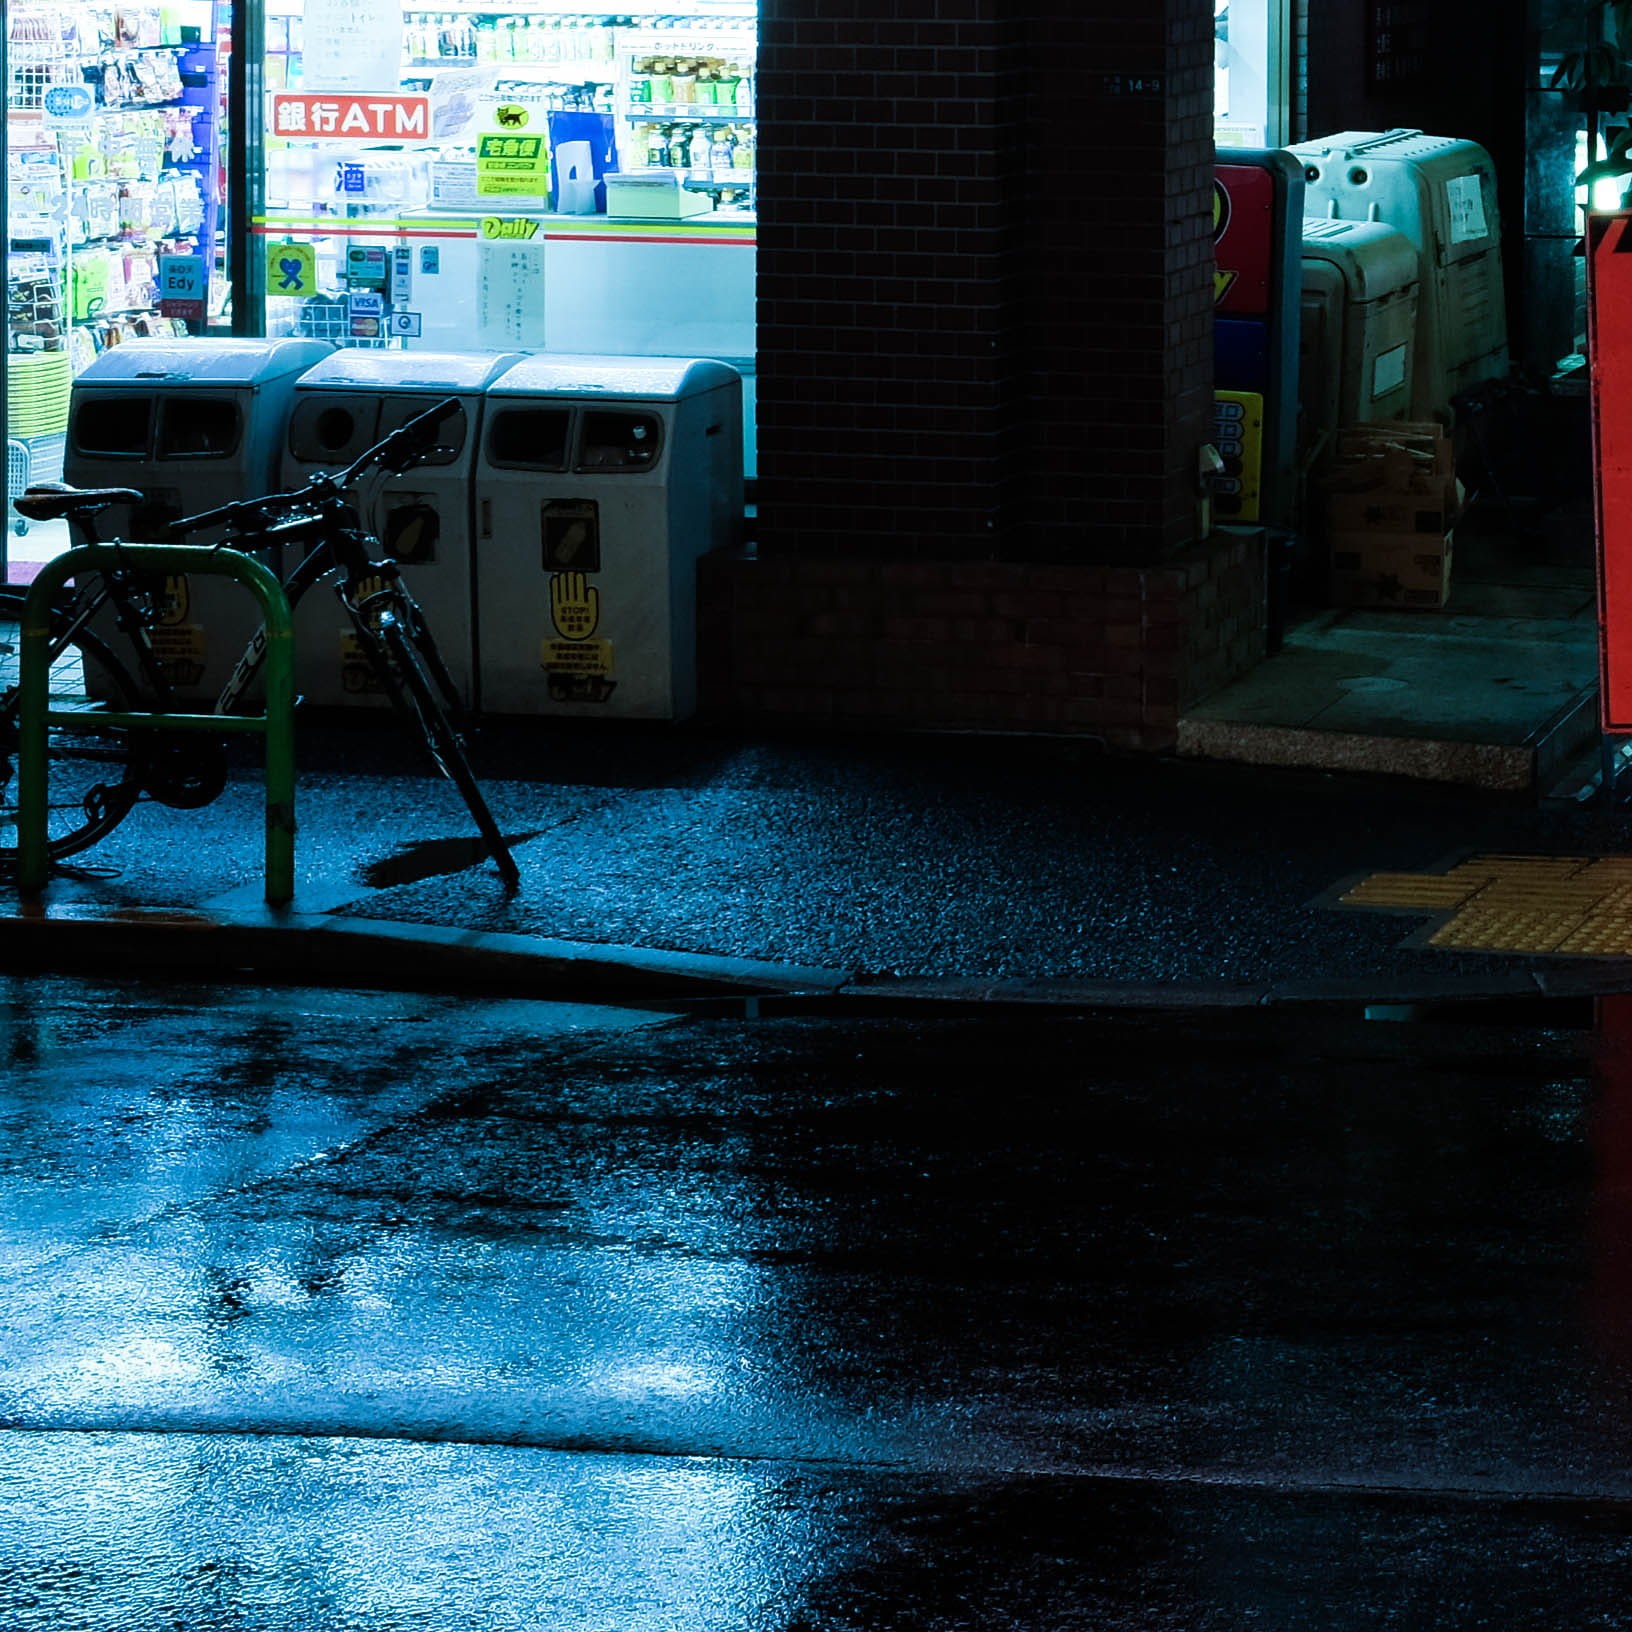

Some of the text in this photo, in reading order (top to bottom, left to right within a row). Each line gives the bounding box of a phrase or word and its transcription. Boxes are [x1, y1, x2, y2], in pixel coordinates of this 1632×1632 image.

[654, 42, 716, 52] ホットドリンク
[278, 102, 424, 135] 銀行ATM
[486, 138, 537, 158] 宅急便
[482, 217, 540, 239] Daily
[168, 277, 195, 291] Edy
[355, 298, 379, 309] VISA
